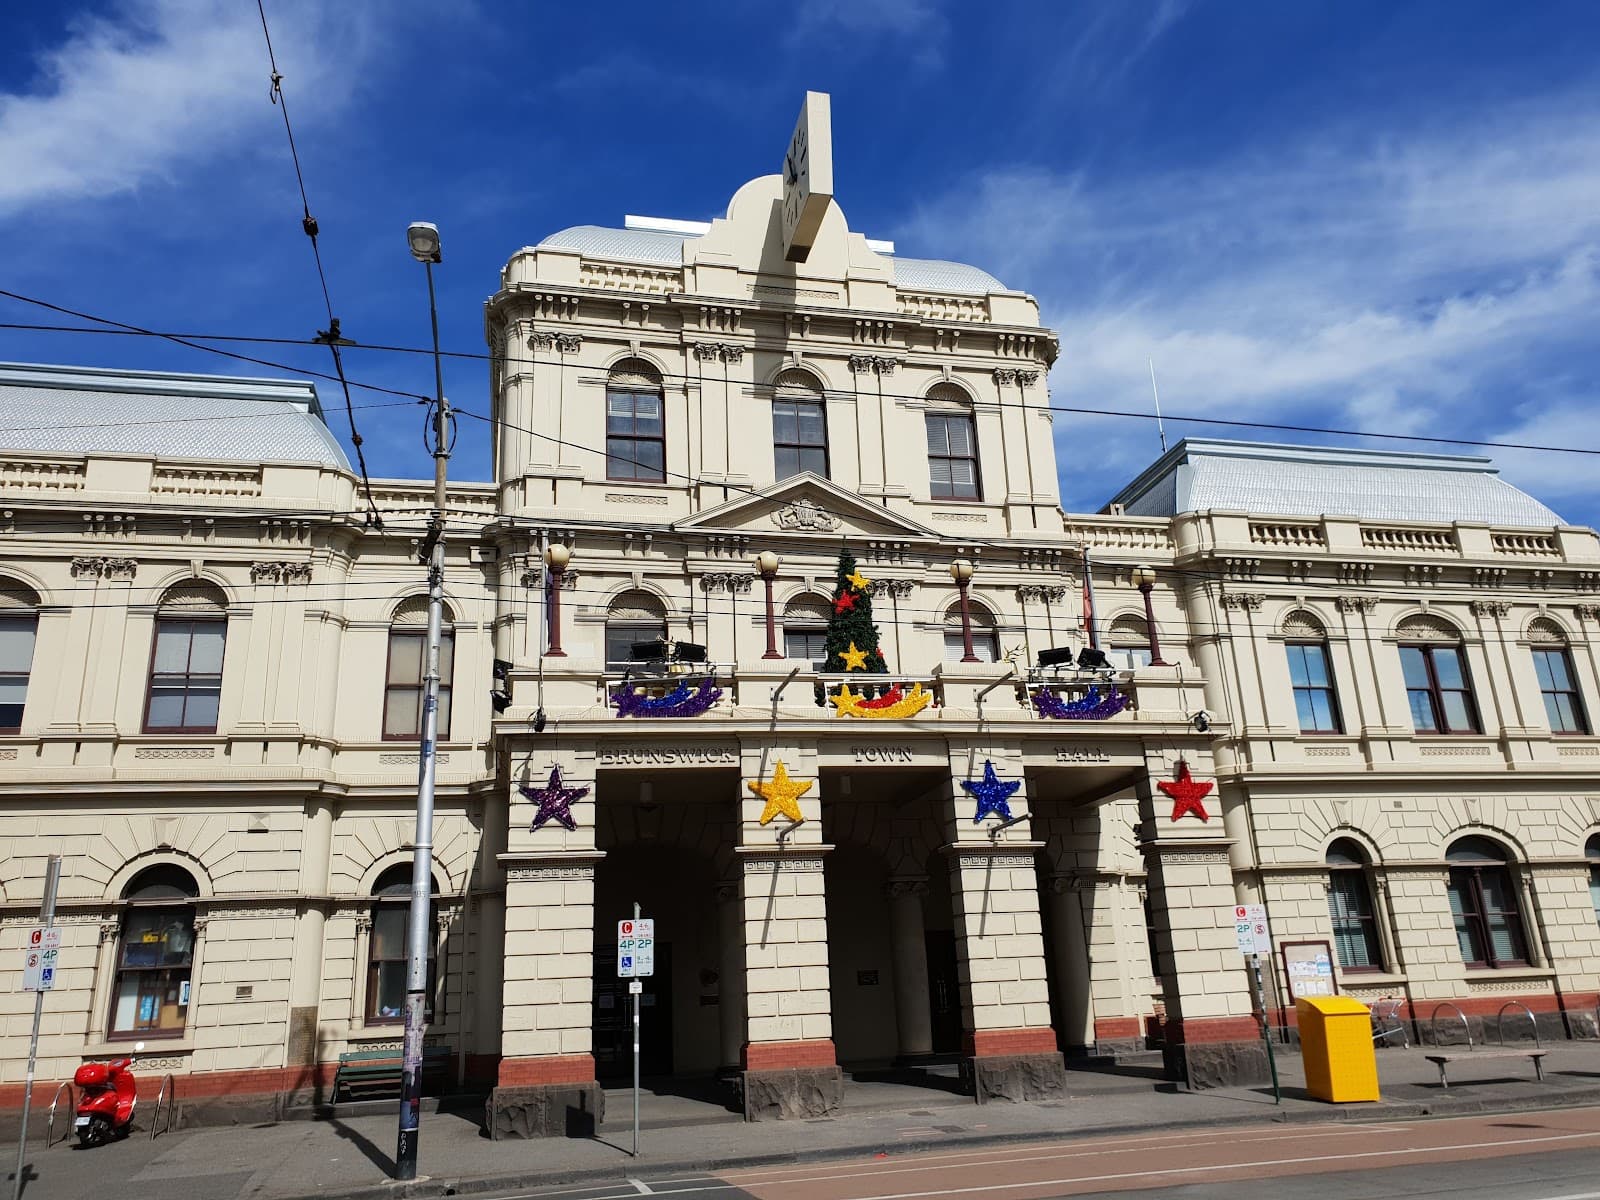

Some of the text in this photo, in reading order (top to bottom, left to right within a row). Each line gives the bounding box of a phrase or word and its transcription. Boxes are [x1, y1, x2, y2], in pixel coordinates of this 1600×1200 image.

[600, 746, 1110, 764] BRUNSWICK TOWN HALL
[1237, 925, 1249, 933] 2P
[620, 939, 652, 948] 4P 2P
[43, 950, 57, 960] 4P
